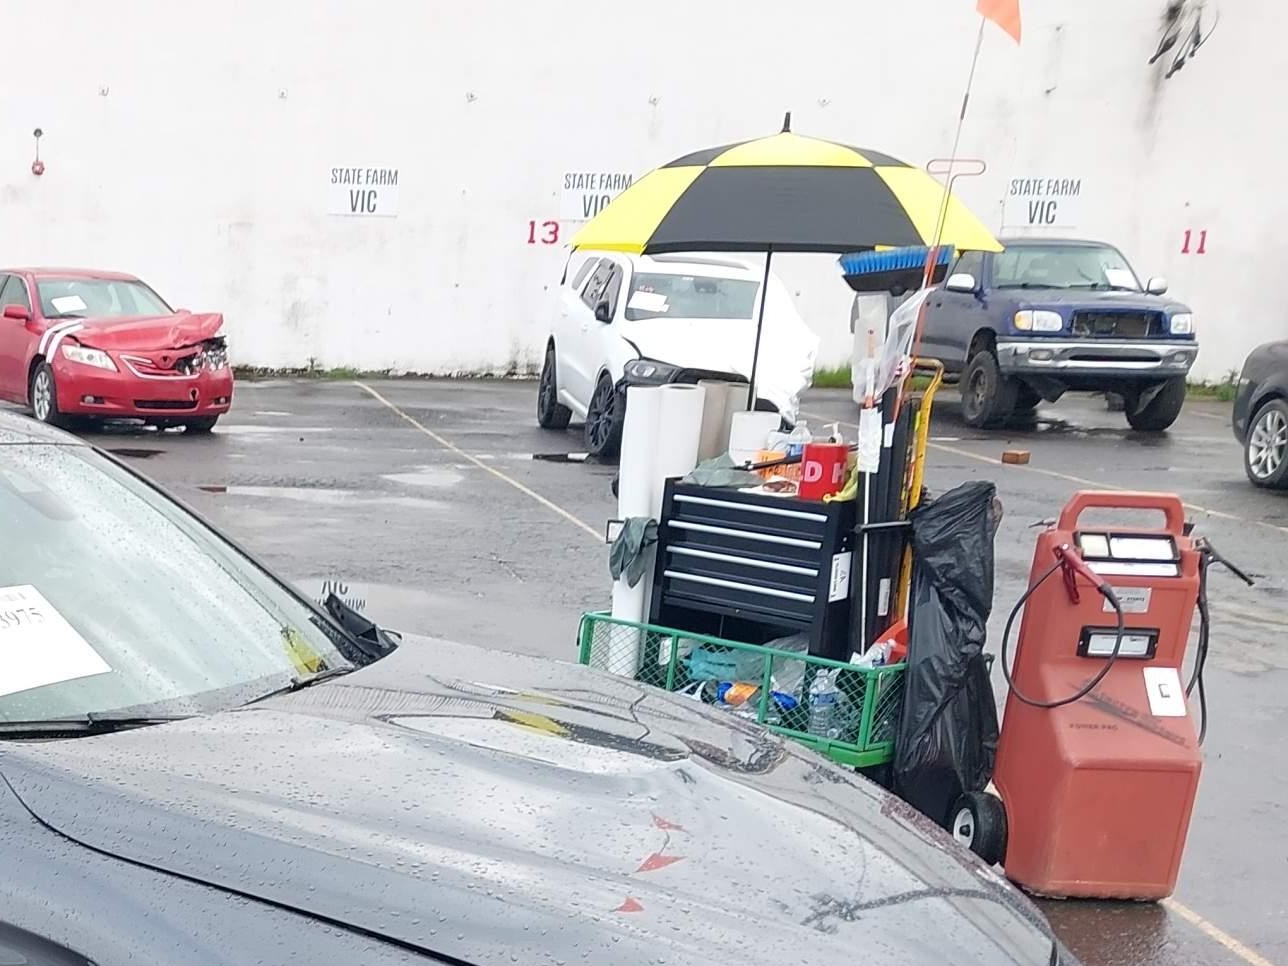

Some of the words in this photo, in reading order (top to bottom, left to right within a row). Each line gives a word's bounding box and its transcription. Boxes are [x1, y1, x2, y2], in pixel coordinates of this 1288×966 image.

[330, 167, 363, 185] STATE
[365, 168, 399, 186] FARM
[563, 172, 596, 190] STATE
[598, 173, 632, 191] FARM
[1010, 178, 1045, 196] STATE
[1045, 178, 1081, 196] FARM
[349, 189, 378, 213] VIC
[1028, 200, 1057, 224] VIC
[527, 220, 559, 244] 13
[1181, 229, 1207, 254] 11
[800, 460, 823, 482] D
